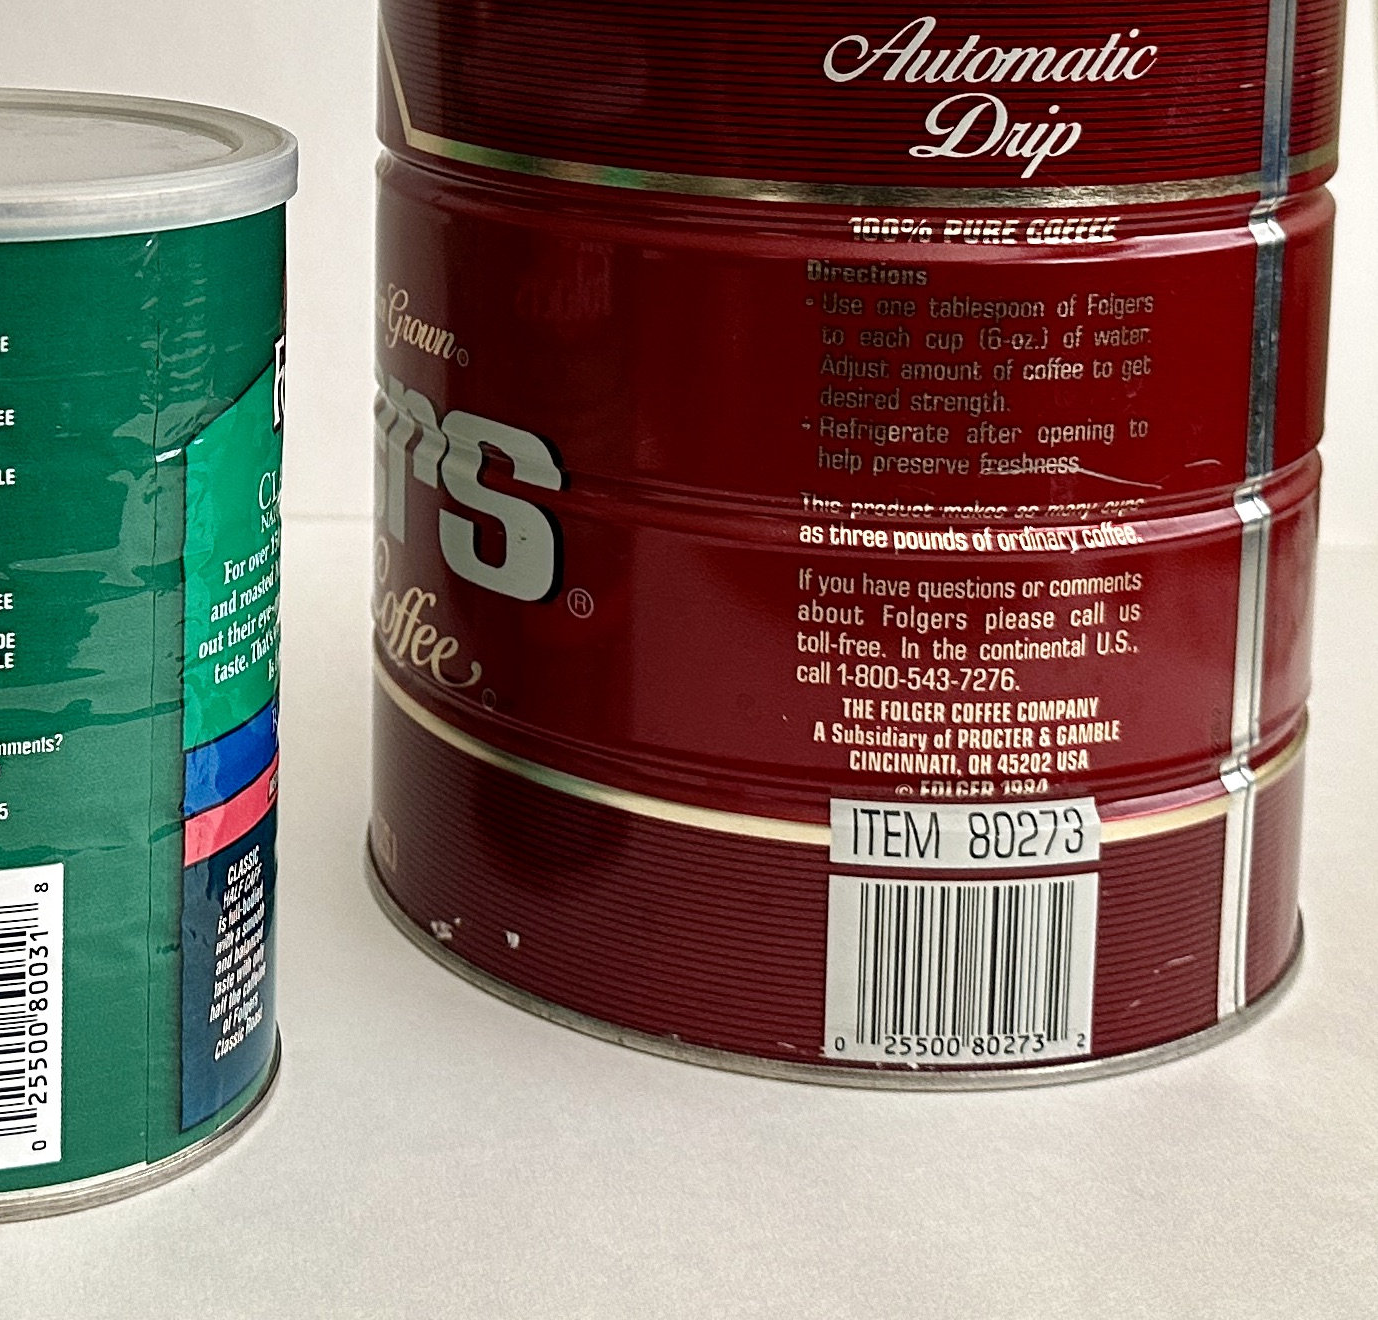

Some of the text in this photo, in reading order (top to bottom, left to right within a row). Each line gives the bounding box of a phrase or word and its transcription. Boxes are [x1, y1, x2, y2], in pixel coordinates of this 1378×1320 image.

[823, 15, 1158, 83] Automatic
[908, 92, 1082, 179] Drip
[848, 216, 1121, 244] 100% PURE COFFEE
[387, 284, 457, 361] Grown
[800, 521, 1144, 555] as three pounds of ordinary coffee.
[223, 559, 245, 585] For
[210, 589, 237, 622] and
[798, 601, 1141, 634] about Folgers please call us
[796, 662, 1020, 692] call 1-800-543-7276.
[814, 720, 1120, 752] A Subsidiary of PROCTER & GAMBLE
[850, 750, 1090, 776] CINCINNATI, OH 45202 USA
[853, 808, 1084, 859] ITEM 80273
[28, 882, 48, 1150] 0 25500 80031 8
[834, 1033, 1086, 1056] 0 25500 80273 2
